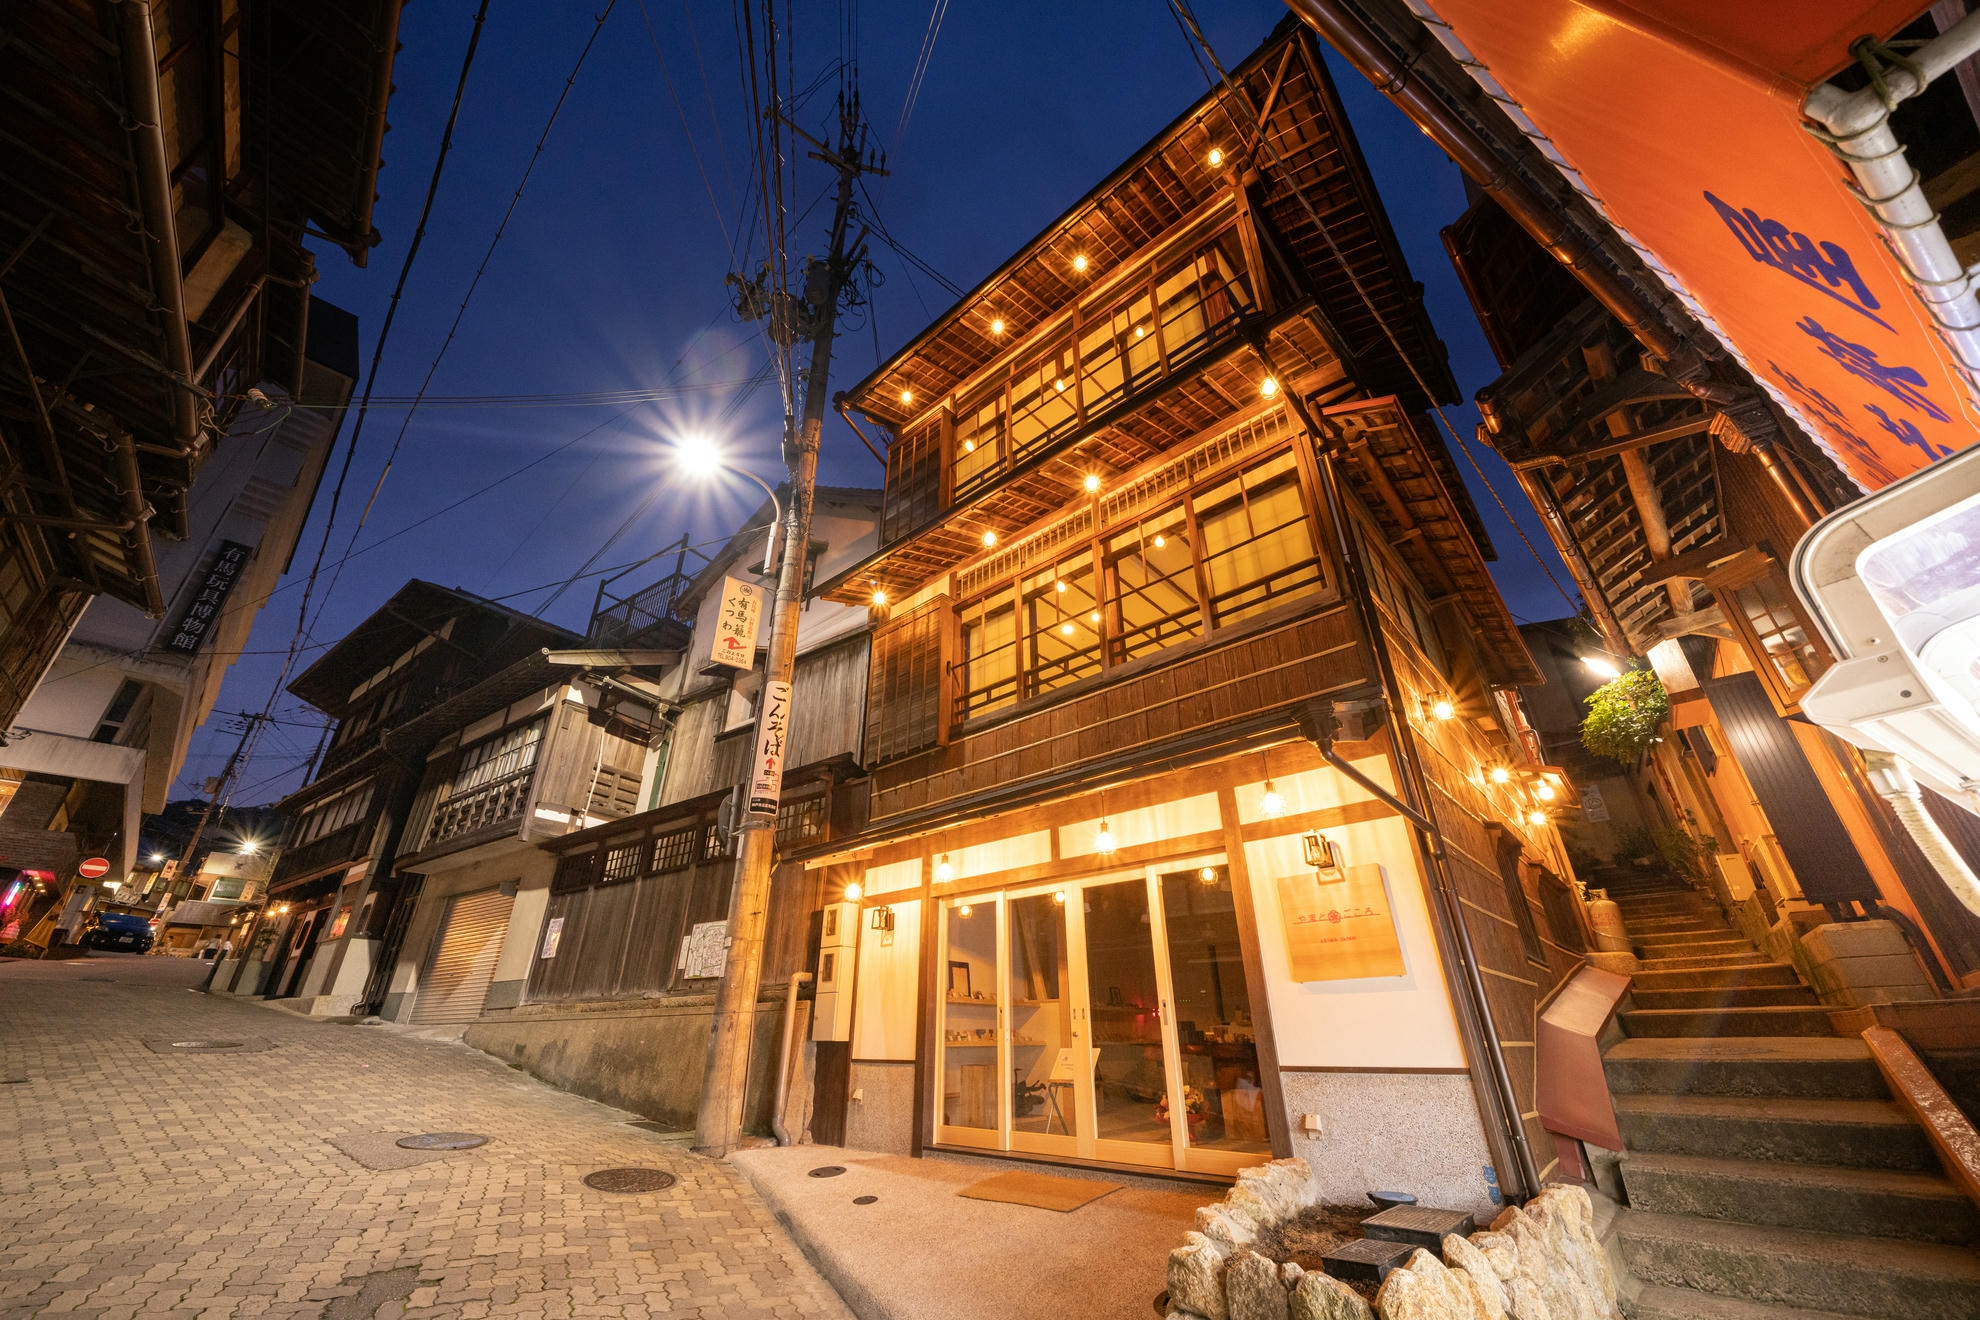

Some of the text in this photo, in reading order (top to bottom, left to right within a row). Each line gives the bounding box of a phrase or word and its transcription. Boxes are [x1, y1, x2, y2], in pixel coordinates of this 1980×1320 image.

[171, 547, 245, 650] 有馬玩具博物館
[722, 597, 737, 631] くつわ
[732, 597, 750, 638] 有馬籠
[764, 686, 789, 757] ごんそば
